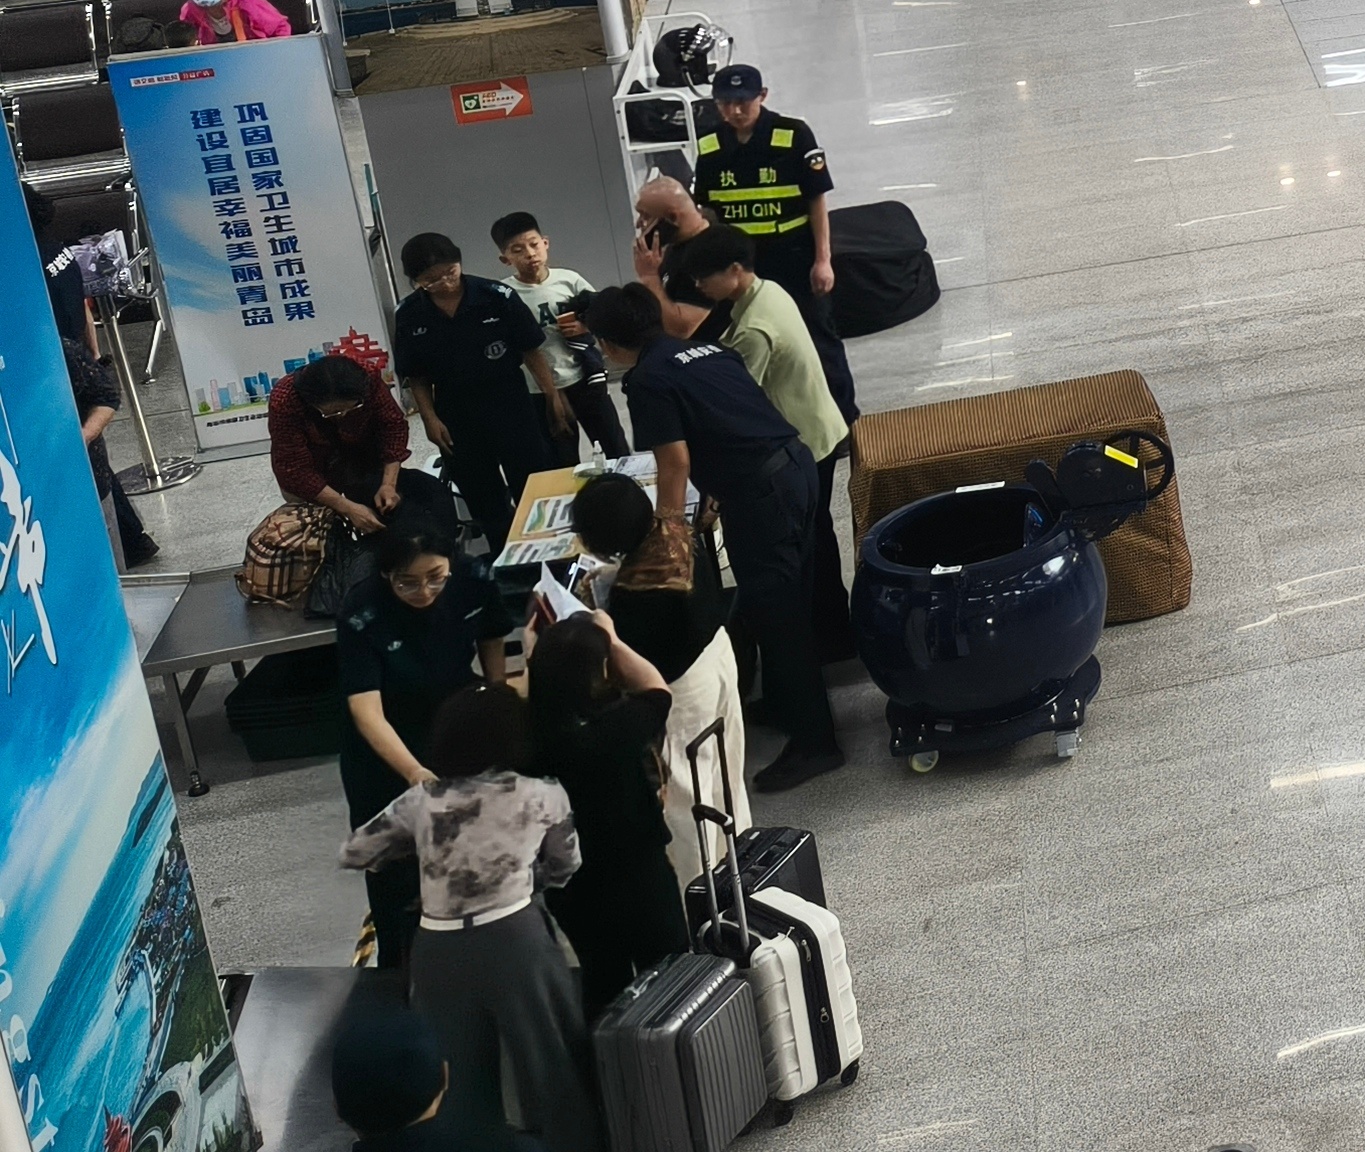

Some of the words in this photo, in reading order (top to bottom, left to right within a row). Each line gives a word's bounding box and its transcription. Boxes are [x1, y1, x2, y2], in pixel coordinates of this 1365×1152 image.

[190, 107, 275, 327] 建设宜居幸福美丽青岛
[233, 101, 316, 322] 巩固国家卫生城市成果
[722, 204, 748, 219] ZHI
[752, 201, 782, 218] QIN
